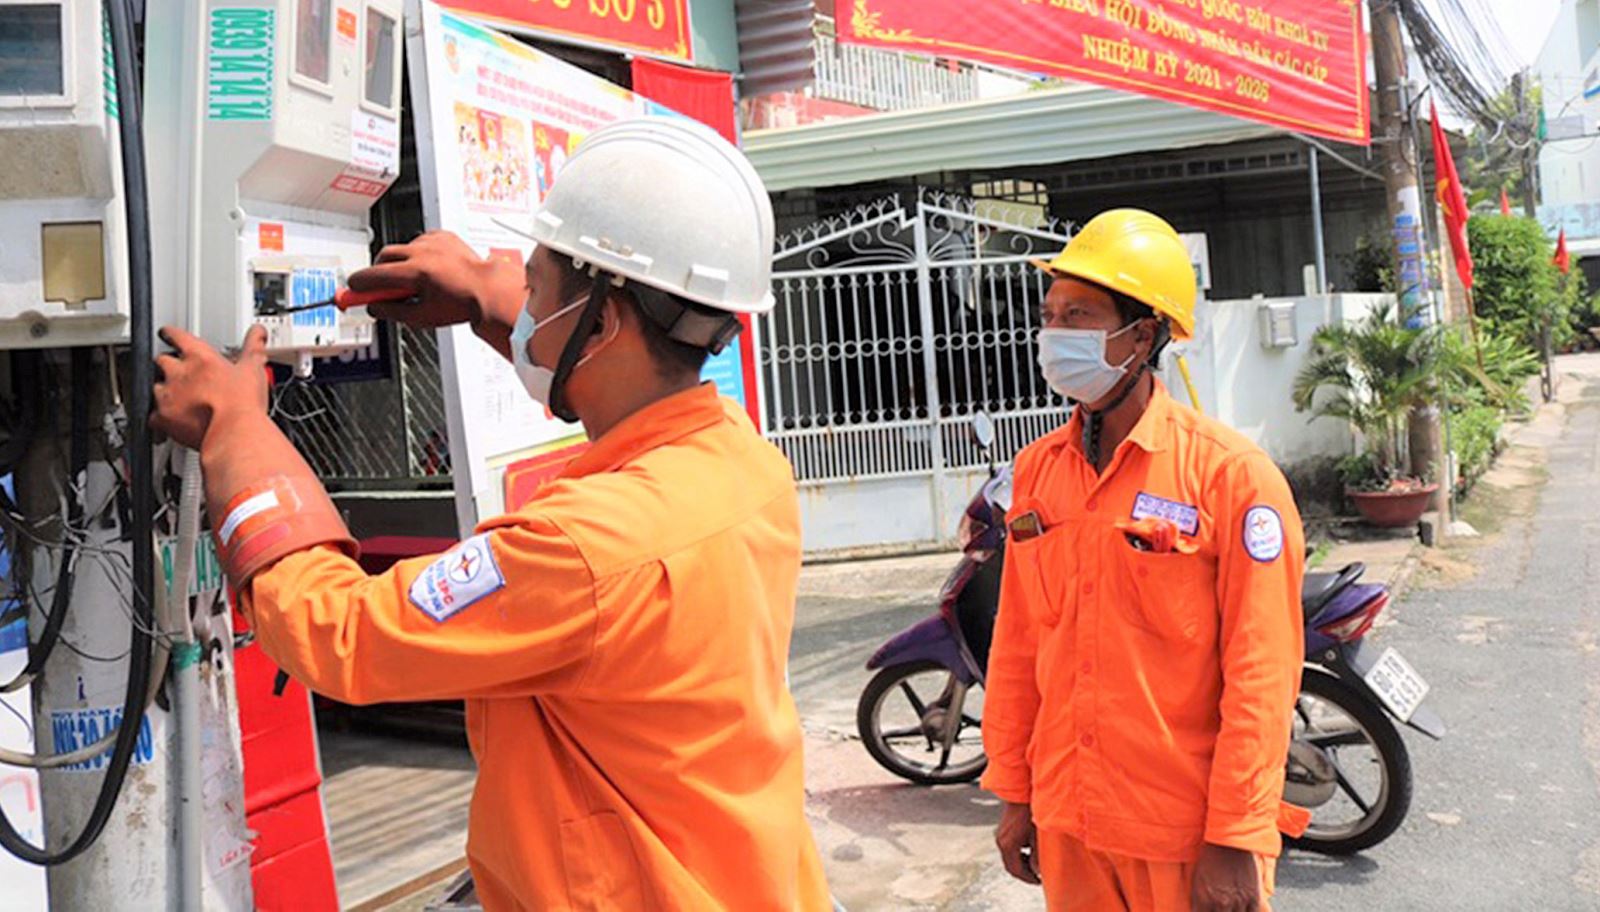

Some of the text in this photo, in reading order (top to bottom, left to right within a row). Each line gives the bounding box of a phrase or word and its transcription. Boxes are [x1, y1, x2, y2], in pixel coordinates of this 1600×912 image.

[1082, 34, 1149, 73] NHIỆM
[1154, 49, 1179, 78] KỲ
[1183, 60, 1221, 90] 2021
[1236, 74, 1270, 103] 2026
